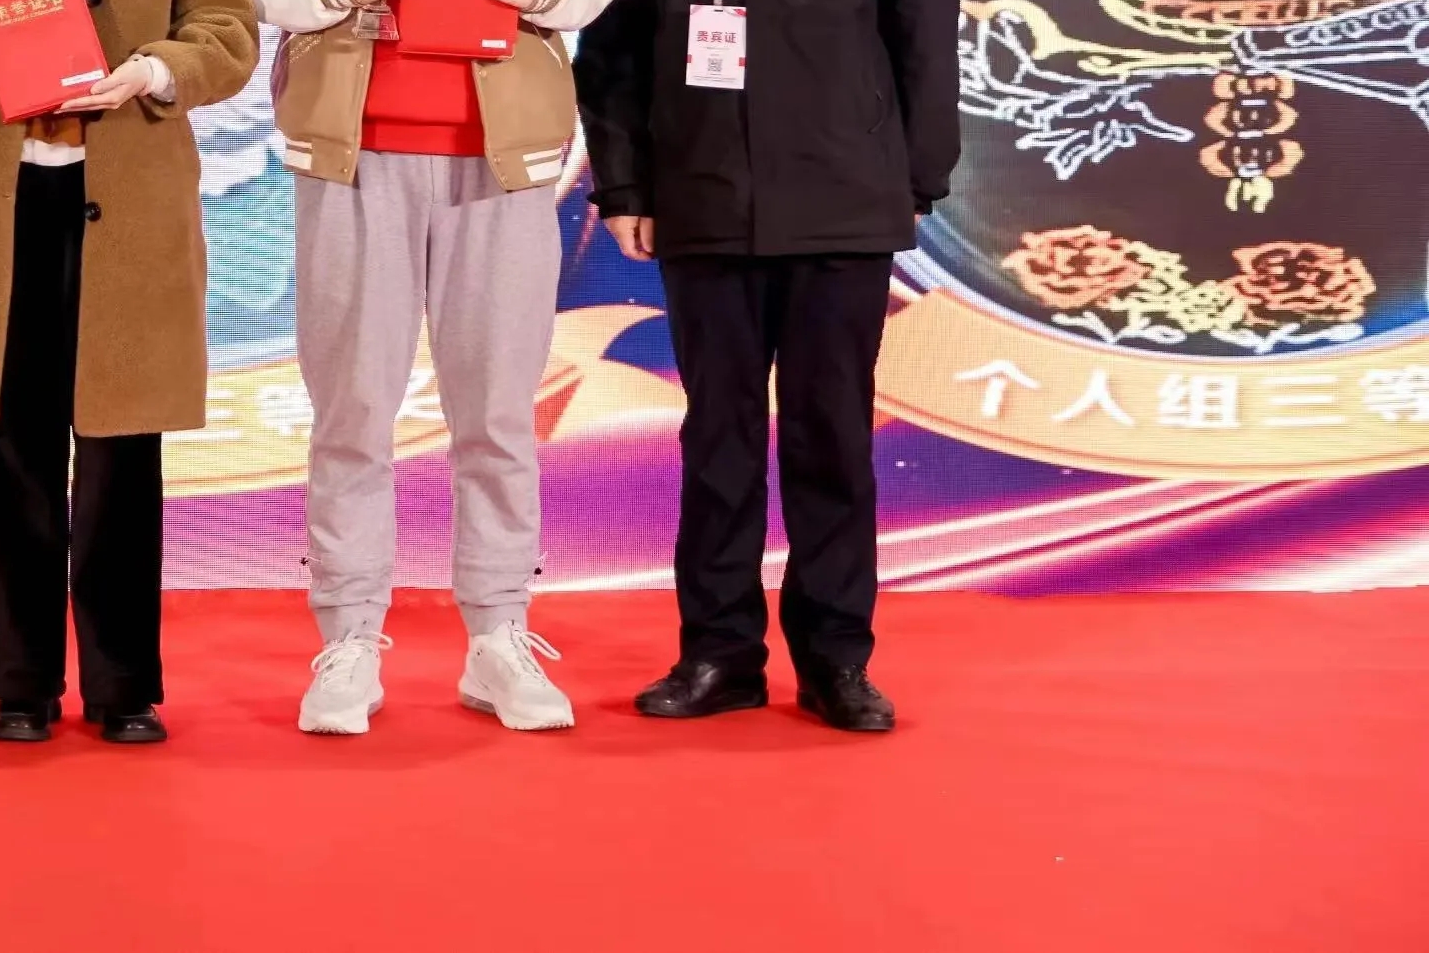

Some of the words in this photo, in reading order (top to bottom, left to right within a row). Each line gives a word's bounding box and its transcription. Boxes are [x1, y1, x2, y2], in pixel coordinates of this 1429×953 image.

[697, 31, 737, 43] 贵宾证
[954, 358, 1429, 430] 个人组三等
